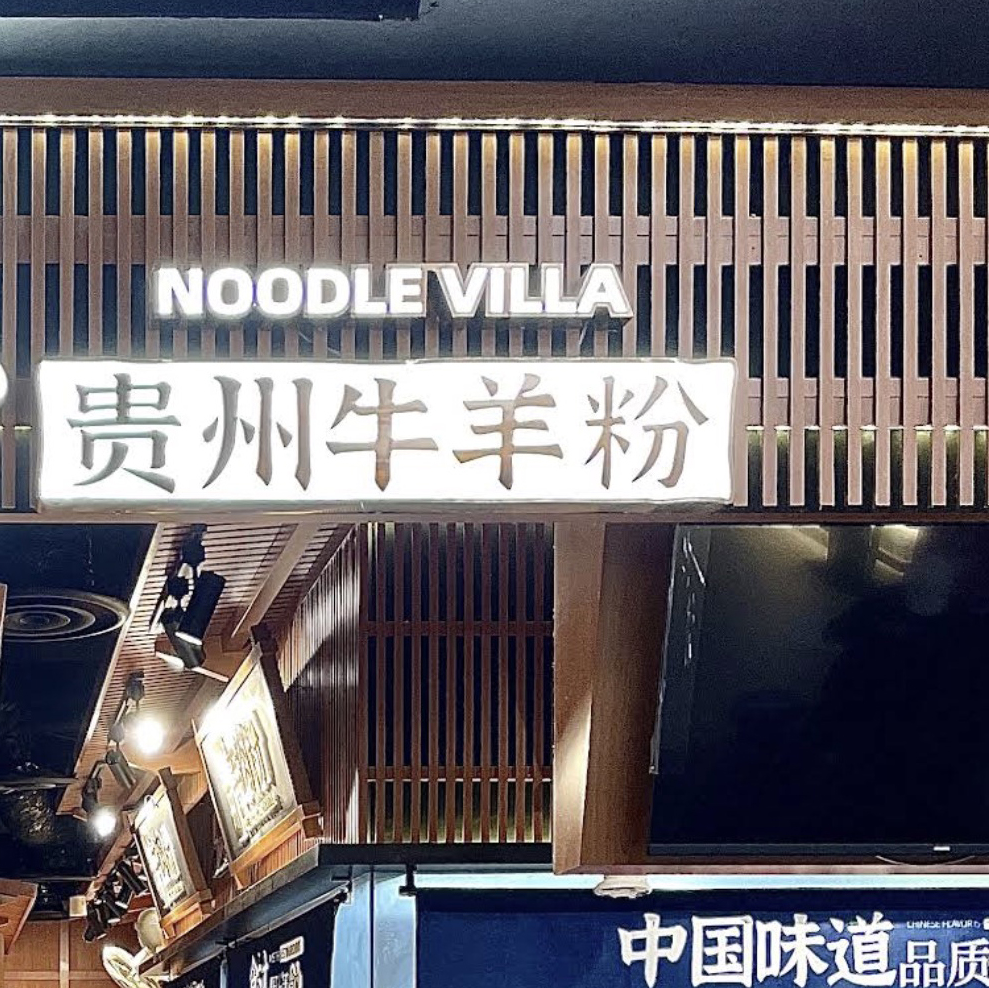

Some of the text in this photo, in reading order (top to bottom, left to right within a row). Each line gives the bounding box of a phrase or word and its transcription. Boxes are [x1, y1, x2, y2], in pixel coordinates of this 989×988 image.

[155, 264, 632, 318] NOODLE VILLA
[65, 372, 709, 494] 贵州牛羊粉
[898, 938, 989, 988] 品质
